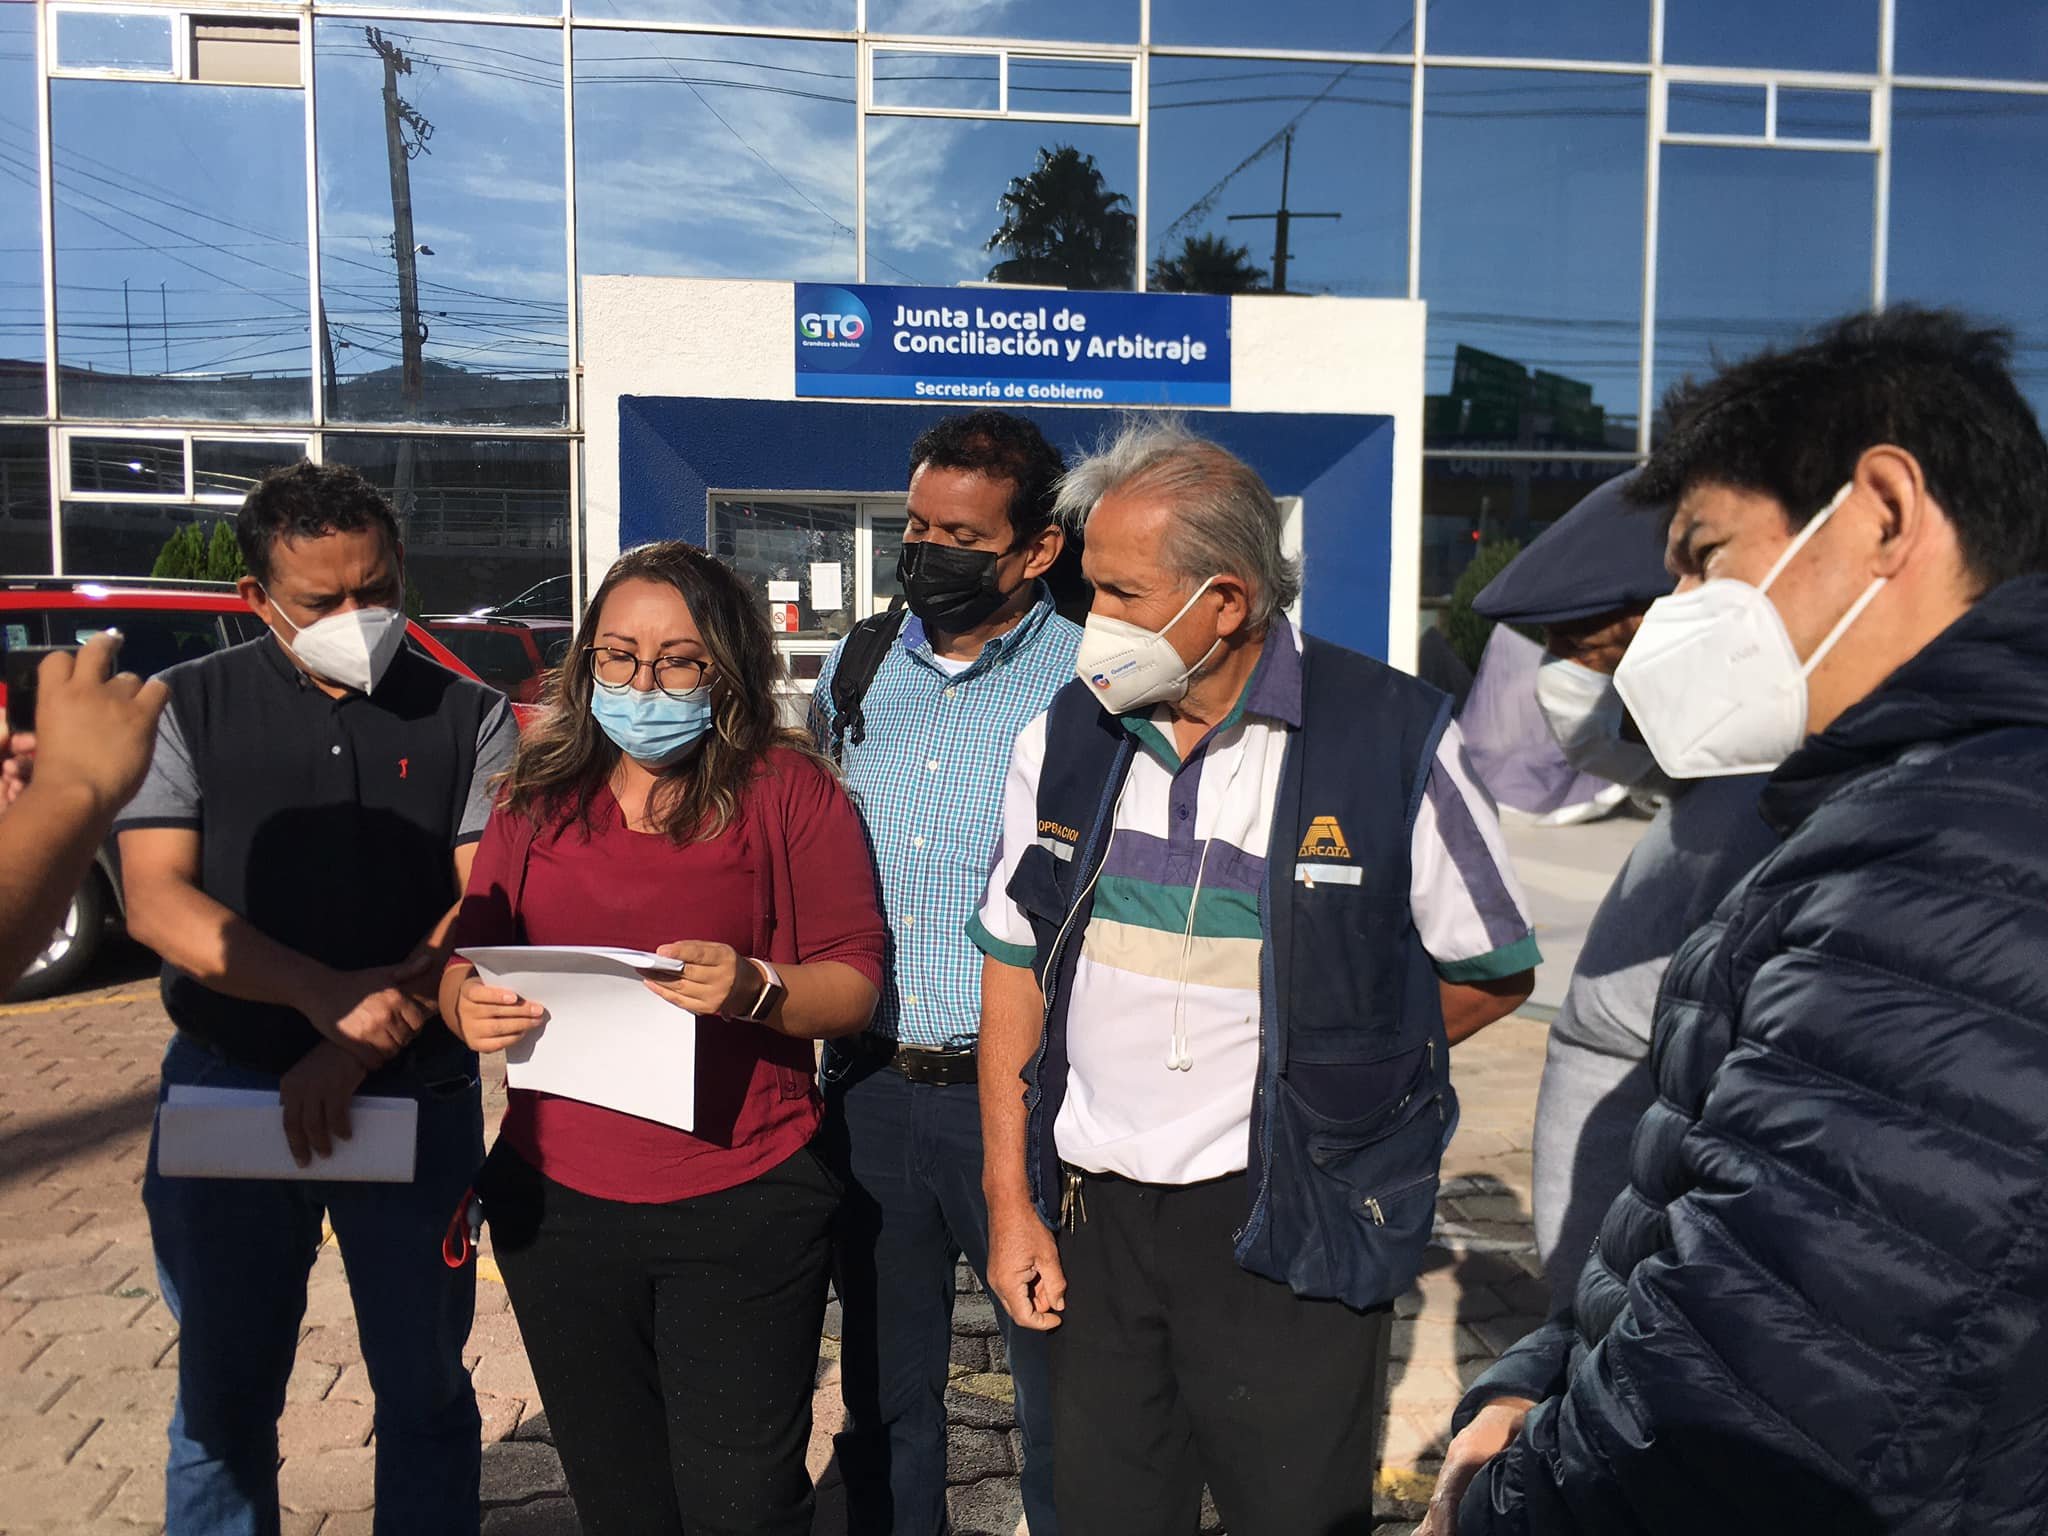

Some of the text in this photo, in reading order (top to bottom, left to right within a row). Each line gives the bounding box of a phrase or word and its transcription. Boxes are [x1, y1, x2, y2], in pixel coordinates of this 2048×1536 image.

[800, 313, 865, 340] GTO
[893, 305, 1086, 332] Junta Local de
[893, 331, 1206, 365] Conciliación y Arbitraje
[915, 382, 1103, 399] Secretaría de Gobierno
[1297, 845, 1351, 858] ARCATA
